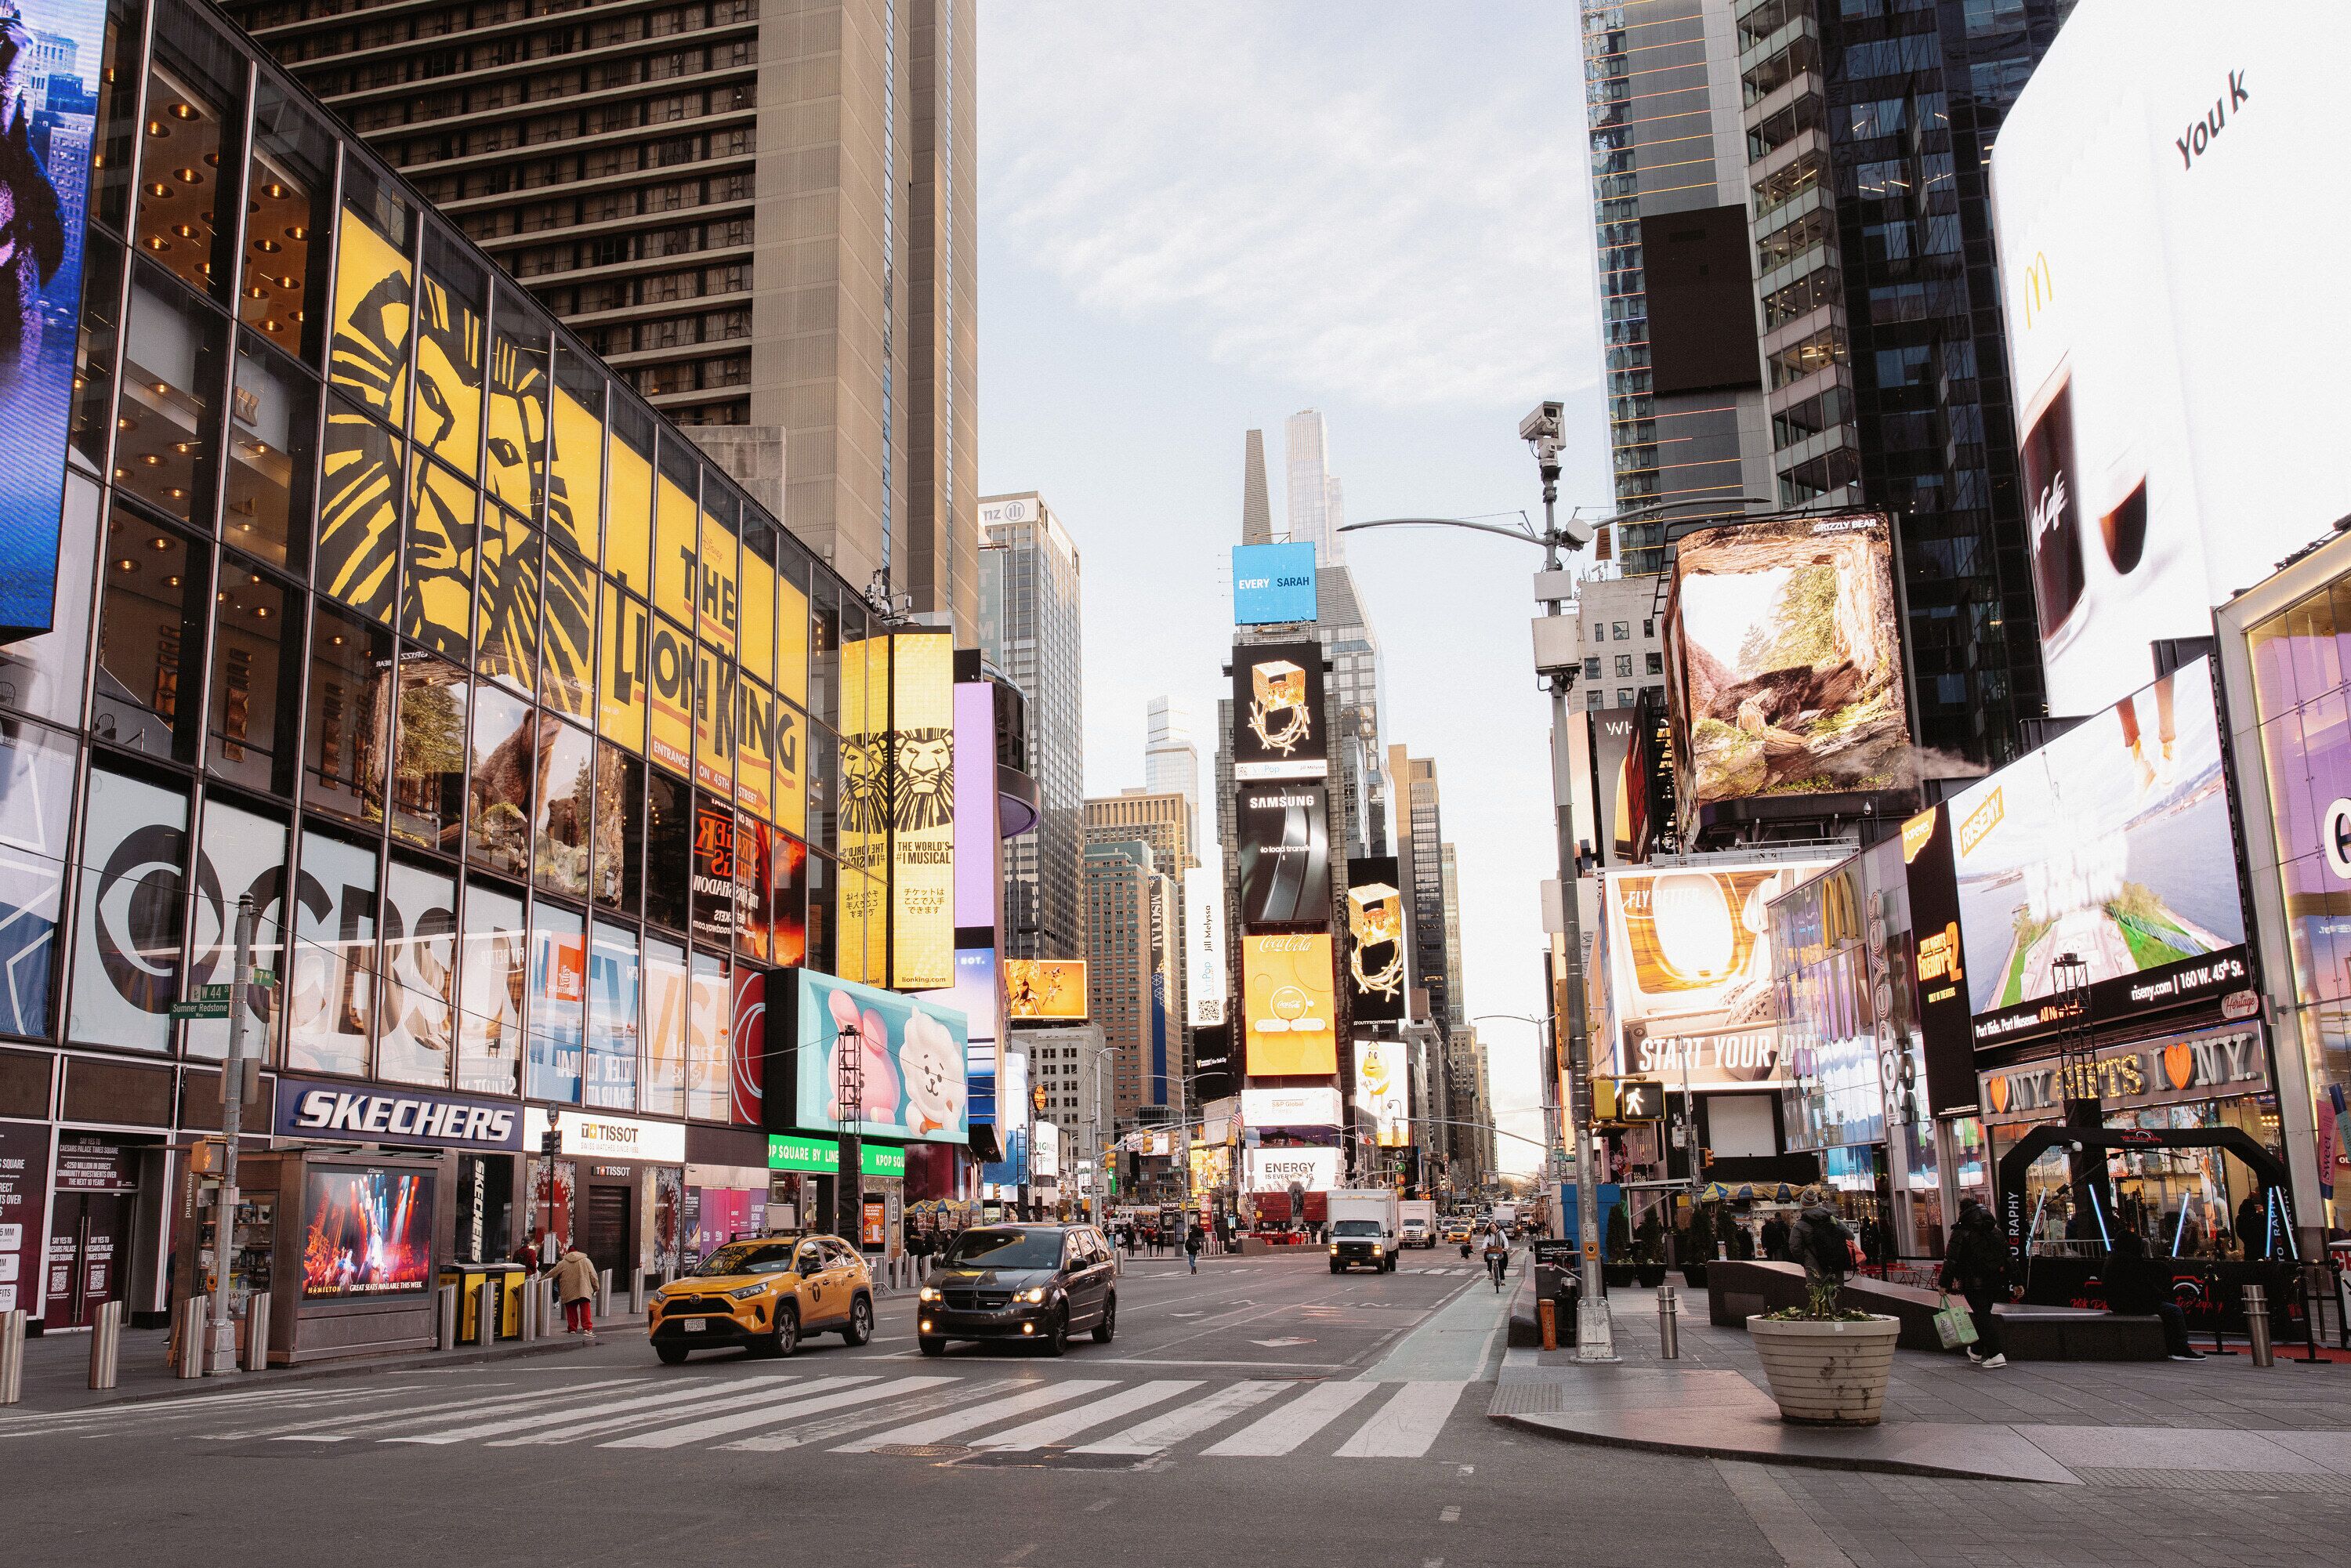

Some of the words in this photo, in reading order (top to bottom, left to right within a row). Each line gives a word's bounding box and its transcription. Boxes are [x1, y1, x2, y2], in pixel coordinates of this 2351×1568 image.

[2175, 95, 2224, 170] You
[2227, 69, 2249, 115] k
[1813, 521, 1850, 533] GRIZZLY
[1851, 519, 1877, 529] BEAR
[680, 545, 734, 632] THE
[1238, 578, 1270, 589] EVERY
[1277, 577, 1310, 587] SARAH
[614, 569, 708, 722] LION
[715, 641, 796, 775] KING
[654, 740, 689, 770] ENTRANCE
[699, 765, 710, 780] ON
[713, 773, 730, 791] 45TH
[738, 786, 757, 805] STREET
[1249, 795, 1314, 808] SAMSUNG
[897, 842, 912, 851] THE
[915, 842, 949, 851] WORLD'S
[911, 852, 951, 864] MUSICAL
[904, 888, 945, 896] チケットは
[1628, 890, 1650, 908] FLY
[907, 906, 940, 914] できます
[1204, 941, 1213, 952] Jill
[1945, 921, 1962, 982] 2
[236, 864, 455, 1050] CBS
[1917, 946, 1953, 981] FREDDY'S
[259, 971, 263, 983] 7
[2131, 979, 2172, 1002] riseny.com
[2179, 971, 2197, 988] 160
[2198, 969, 2212, 984] W.
[2212, 958, 2230, 983] 45th
[2231, 961, 2244, 978] St.
[202, 987, 208, 998] W
[210, 987, 221, 998] 44
[172, 1004, 197, 1012] Sumner
[199, 1003, 227, 1012] Redstone
[2224, 994, 2255, 1014] Heritage
[1976, 1024, 1987, 1037] Part
[1987, 1019, 2001, 1035] Ride.
[2001, 1017, 2014, 1032] Part
[2014, 1014, 2039, 1029] Museum.
[1639, 1036, 1705, 1072] START
[1714, 1035, 1772, 1068] YOUR
[2056, 1052, 2146, 1099] GIFTS
[295, 1090, 516, 1142] SKECHERS
[599, 1124, 639, 1143] TISSOT
[2, 1159, 25, 1169] SQUARE
[779, 1145, 809, 1161] SQUARE
[813, 1148, 821, 1161] BY
[825, 1150, 839, 1163] LINE
[876, 1154, 892, 1167] KPOP
[605, 1166, 630, 1176] TISSOT
[1265, 1162, 1315, 1173] ENERGY
[0, 1182, 13, 1193] RECT
[185, 1171, 195, 1219] Newsstand
[6, 1194, 21, 1204] OVER
[472, 1159, 484, 1263] SKECHERS
